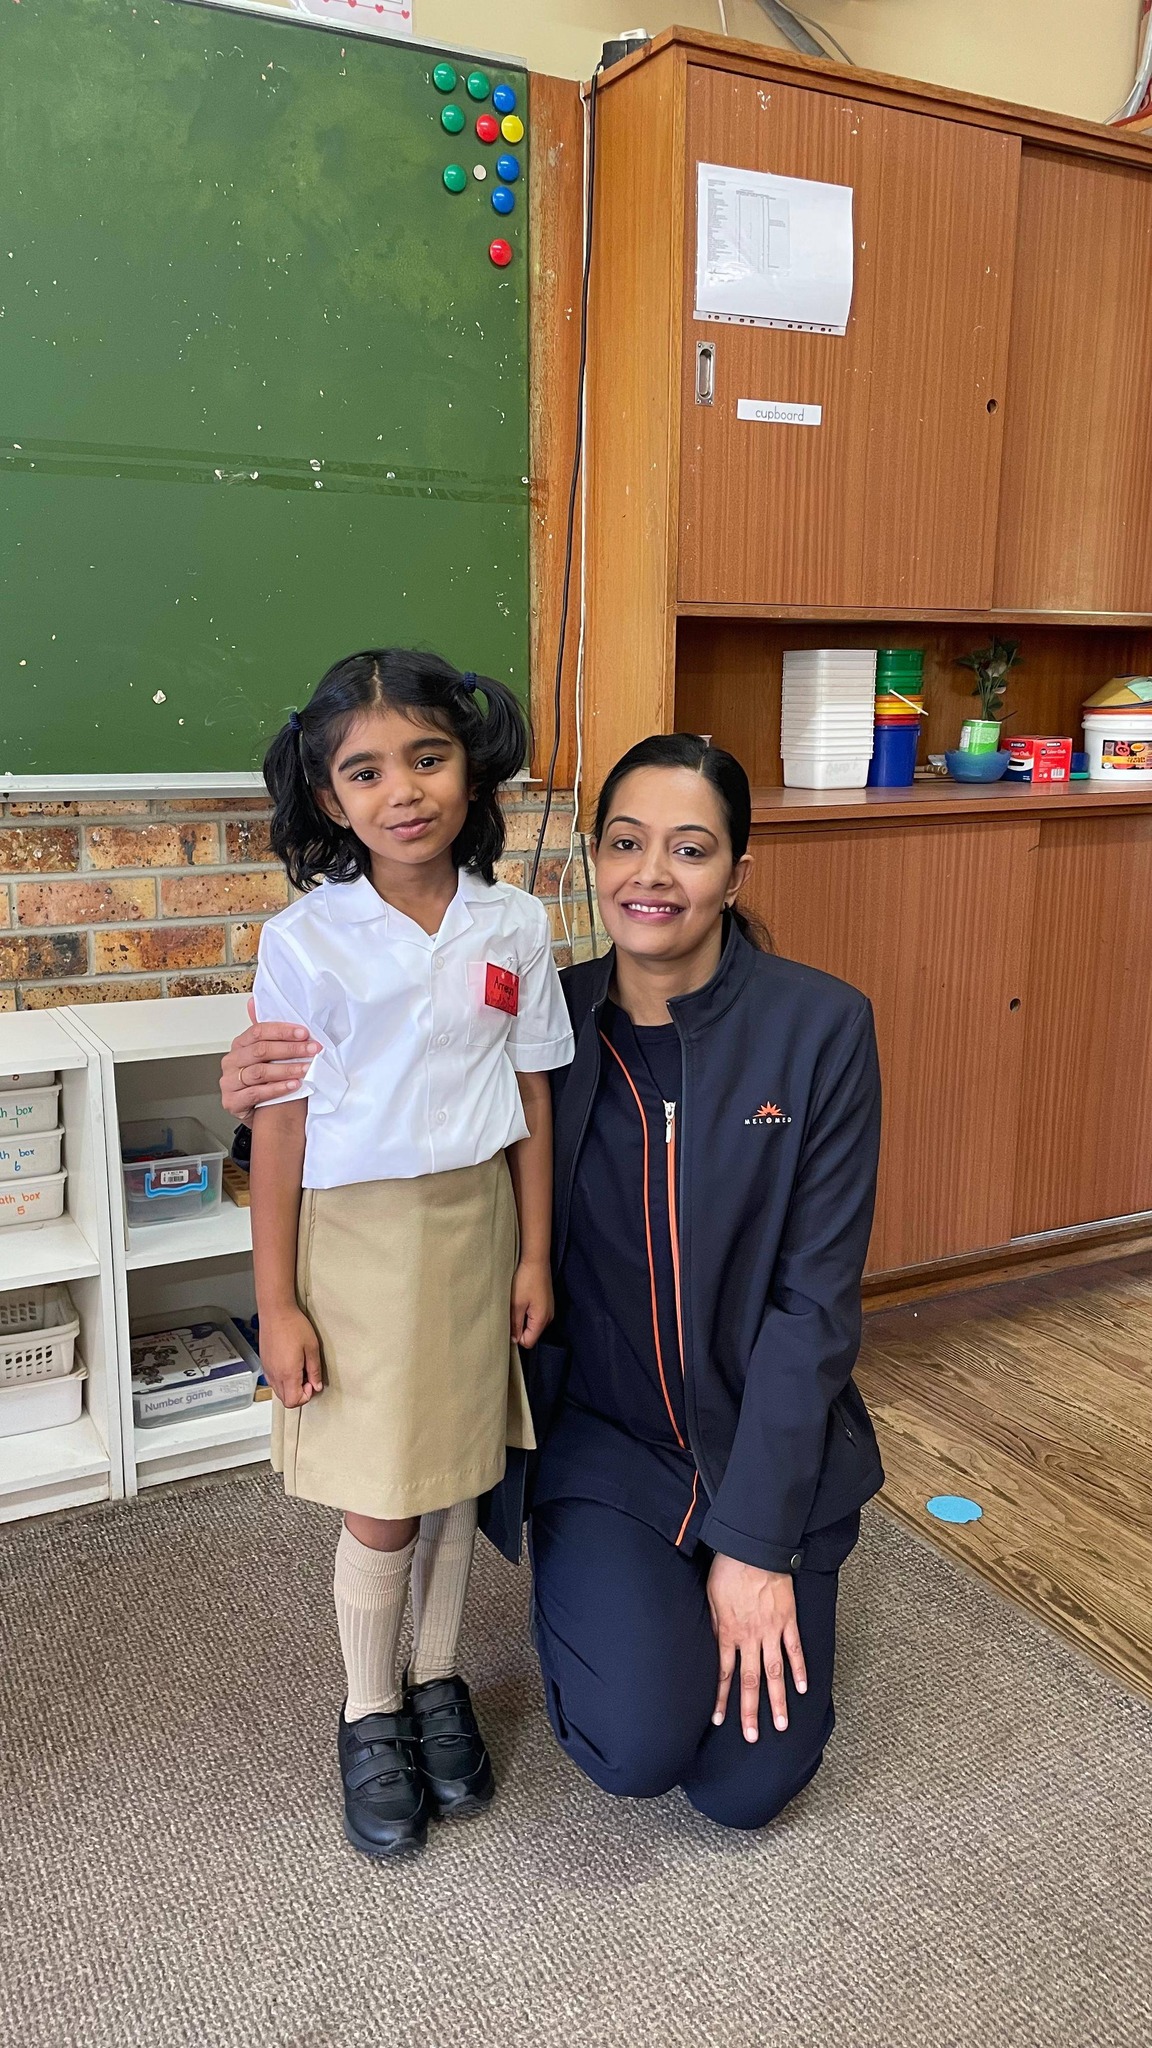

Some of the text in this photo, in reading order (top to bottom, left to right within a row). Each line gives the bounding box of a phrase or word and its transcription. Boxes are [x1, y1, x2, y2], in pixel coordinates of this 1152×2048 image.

[755, 405, 805, 421] cupboard
[15, 1105, 34, 1116] box
[9, 1117, 19, 1128] 7
[744, 1117, 792, 1125] MELOMED
[18, 1148, 35, 1158] box
[0, 1191, 41, 1205] ath box
[17, 1205, 26, 1216] 5
[145, 1389, 213, 1413] Number game
